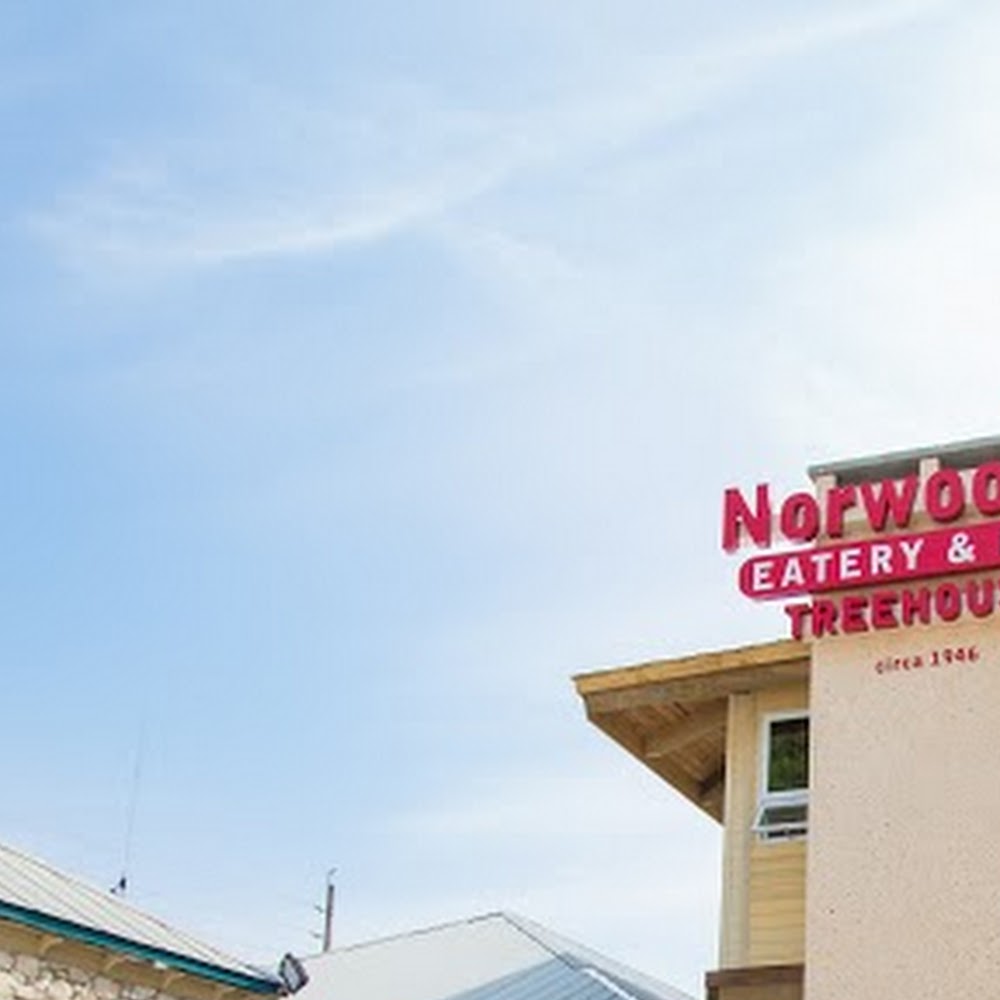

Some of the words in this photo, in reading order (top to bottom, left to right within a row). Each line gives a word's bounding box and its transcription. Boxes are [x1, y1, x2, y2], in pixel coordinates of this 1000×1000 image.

[752, 539, 924, 591] EATERY
[947, 533, 975, 563] &
[875, 656, 923, 674] circa
[930, 646, 980, 666] 1946
